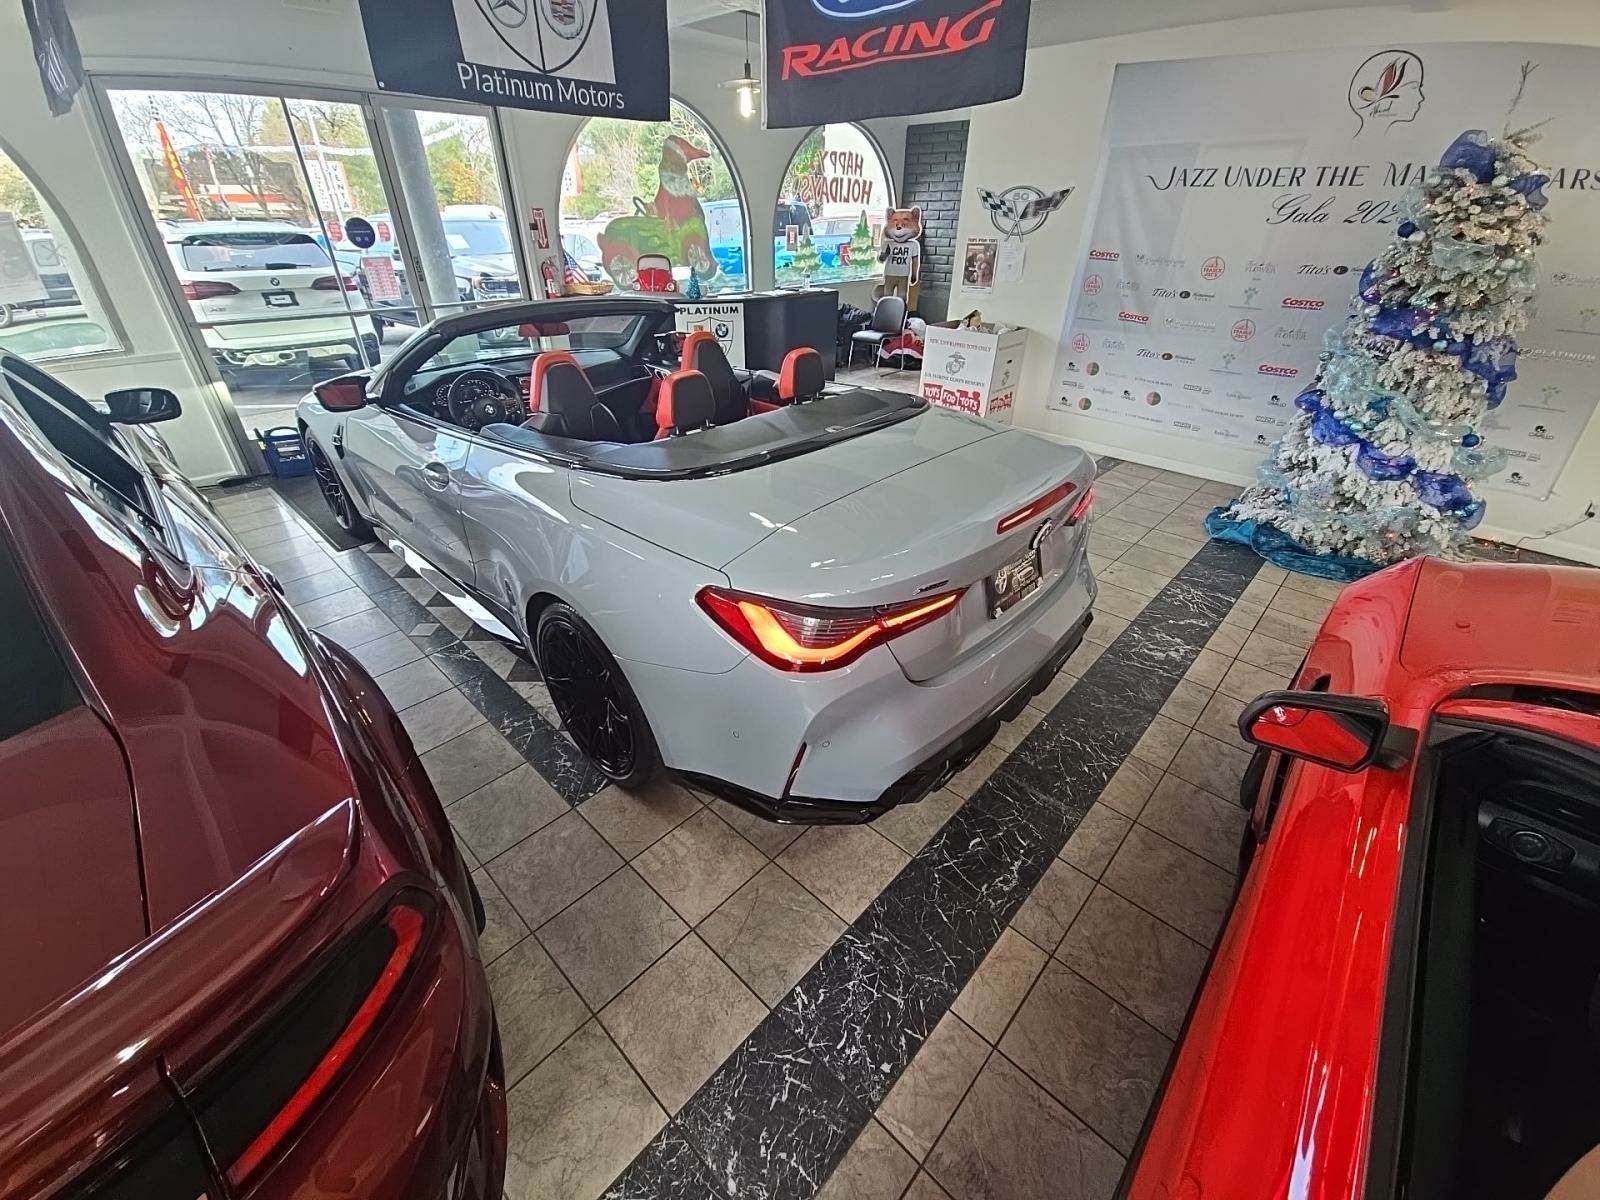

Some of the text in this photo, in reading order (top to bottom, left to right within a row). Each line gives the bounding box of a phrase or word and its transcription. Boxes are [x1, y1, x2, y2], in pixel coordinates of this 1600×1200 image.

[781, 0, 1003, 80] RACING
[456, 62, 625, 109] Platinum Motors
[1145, 166, 1218, 191] JAZZ
[1224, 165, 1307, 188] UNDER
[1315, 165, 1371, 188] THE
[1546, 167, 1600, 191] ARS
[1266, 193, 1406, 225] Gala 202
[892, 247, 909, 256] CAR
[1089, 249, 1120, 259] COSTCO
[891, 256, 908, 265] FOX
[1297, 264, 1331, 275] Tito's
[1151, 288, 1177, 299] Tito's
[1282, 297, 1325, 308] COSTCO
[679, 305, 739, 315] PLATINUM
[1118, 311, 1149, 322] COSTCO
[1259, 364, 1298, 375] COSTCO
[924, 386, 940, 398] TOYS
[943, 392, 956, 403] FOR
[960, 396, 979, 411] TOTS
